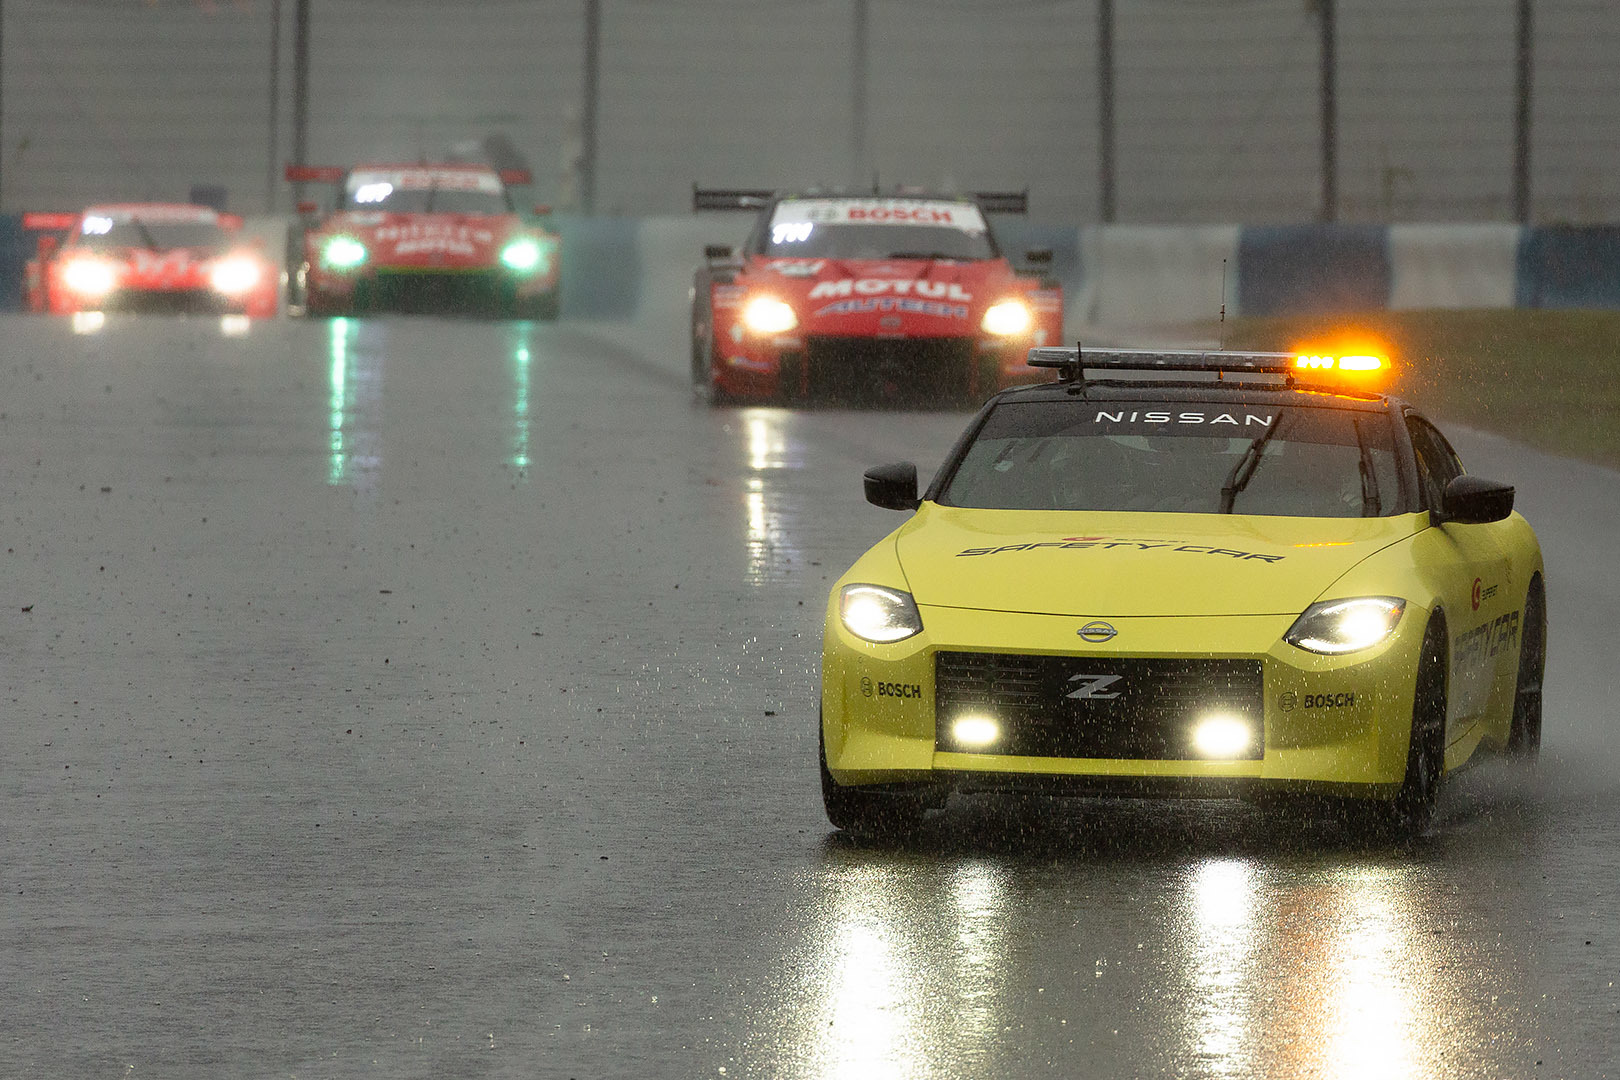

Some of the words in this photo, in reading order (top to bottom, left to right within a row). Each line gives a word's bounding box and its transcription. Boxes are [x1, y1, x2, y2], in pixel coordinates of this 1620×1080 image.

[847, 206, 953, 223] BOSCH
[808, 279, 973, 301] MOTUL
[1095, 410, 1274, 427] NISSAN
[956, 541, 1171, 558] SAFETY
[1173, 546, 1286, 563] CAR
[1490, 610, 1519, 657] CAR
[878, 681, 922, 699] BOSCH
[1066, 674, 1123, 699] Z
[1304, 691, 1356, 709] BOSCH
